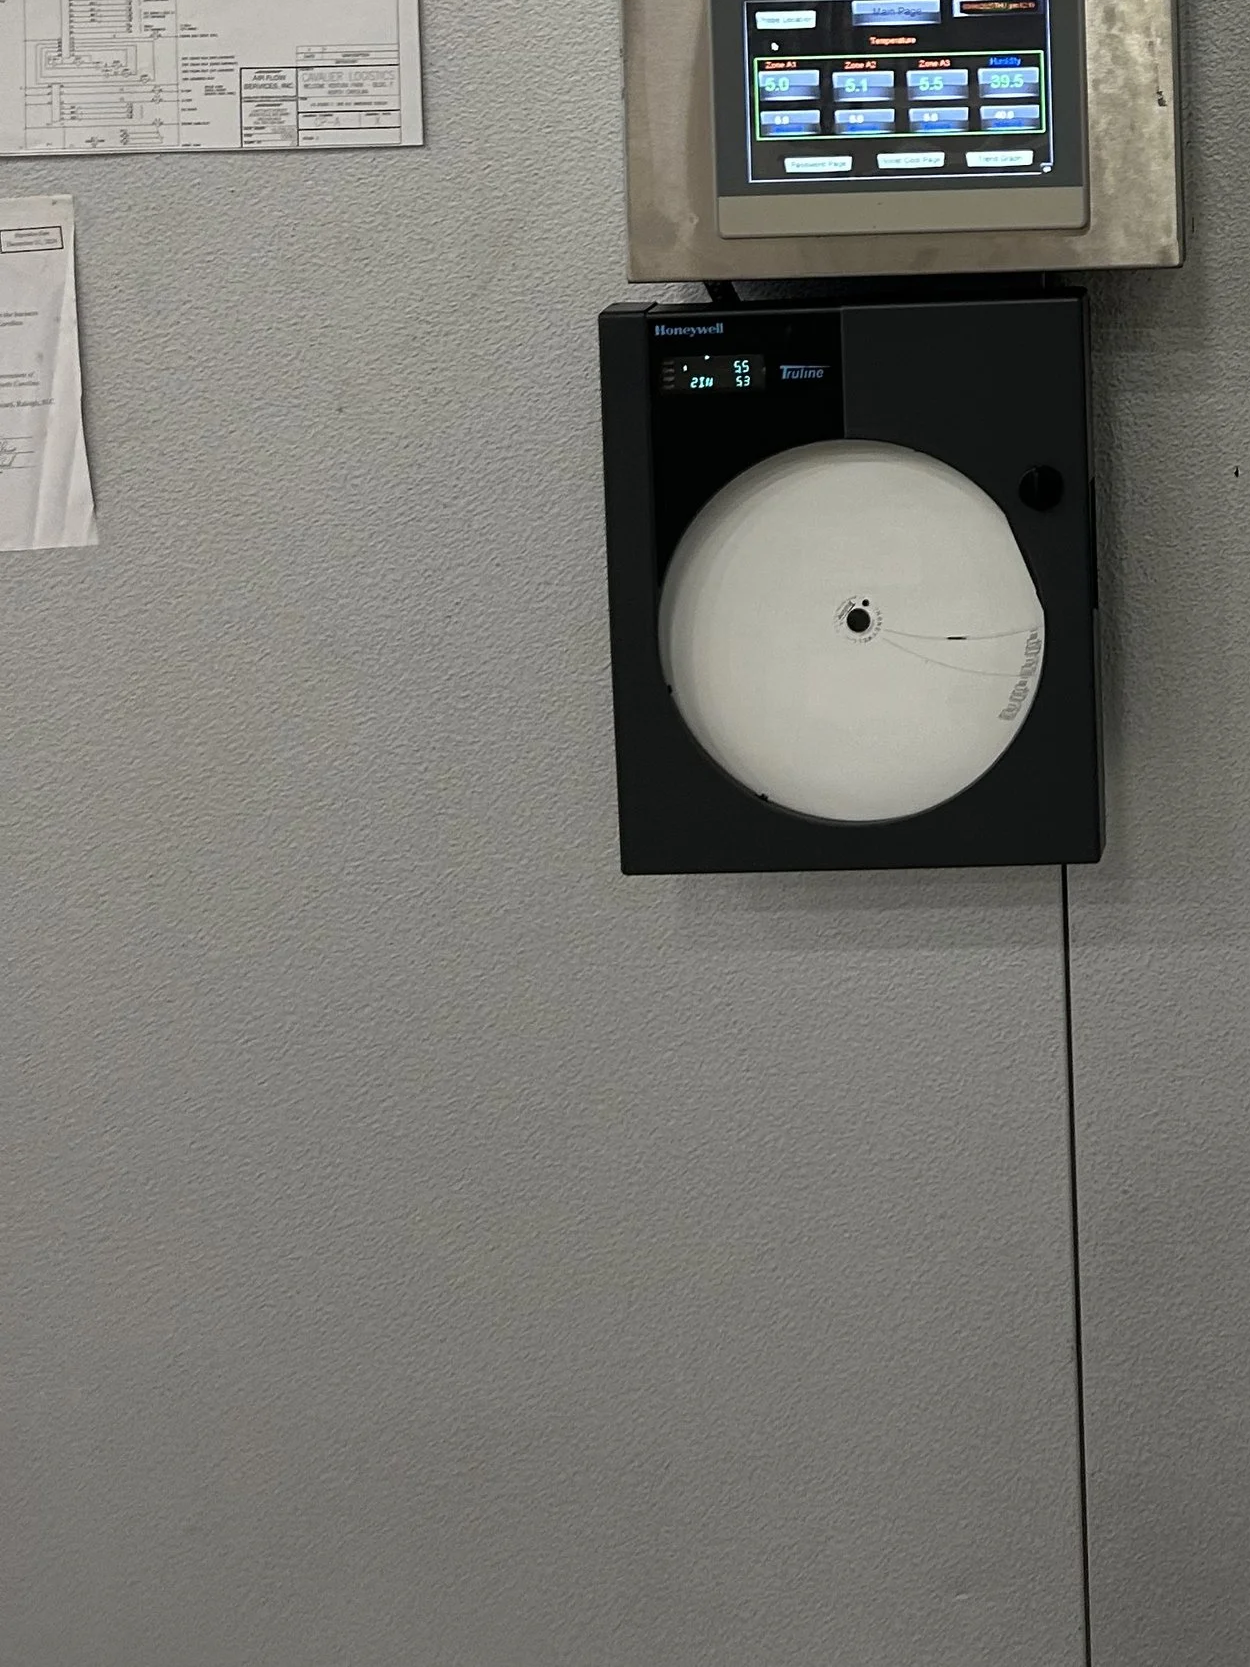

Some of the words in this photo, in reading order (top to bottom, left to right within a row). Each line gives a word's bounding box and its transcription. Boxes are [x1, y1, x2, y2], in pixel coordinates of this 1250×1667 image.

[898, 6, 922, 18] Page
[764, 61, 785, 70] Zone
[844, 61, 865, 70] Zone
[918, 59, 939, 68] Zone
[844, 77, 868, 93] 5.1
[919, 76, 944, 91] 5.5
[990, 73, 1025, 89] 39.5
[654, 322, 724, 337] Honeywell
[779, 365, 831, 380] Truline
[736, 375, 751, 388] 53
